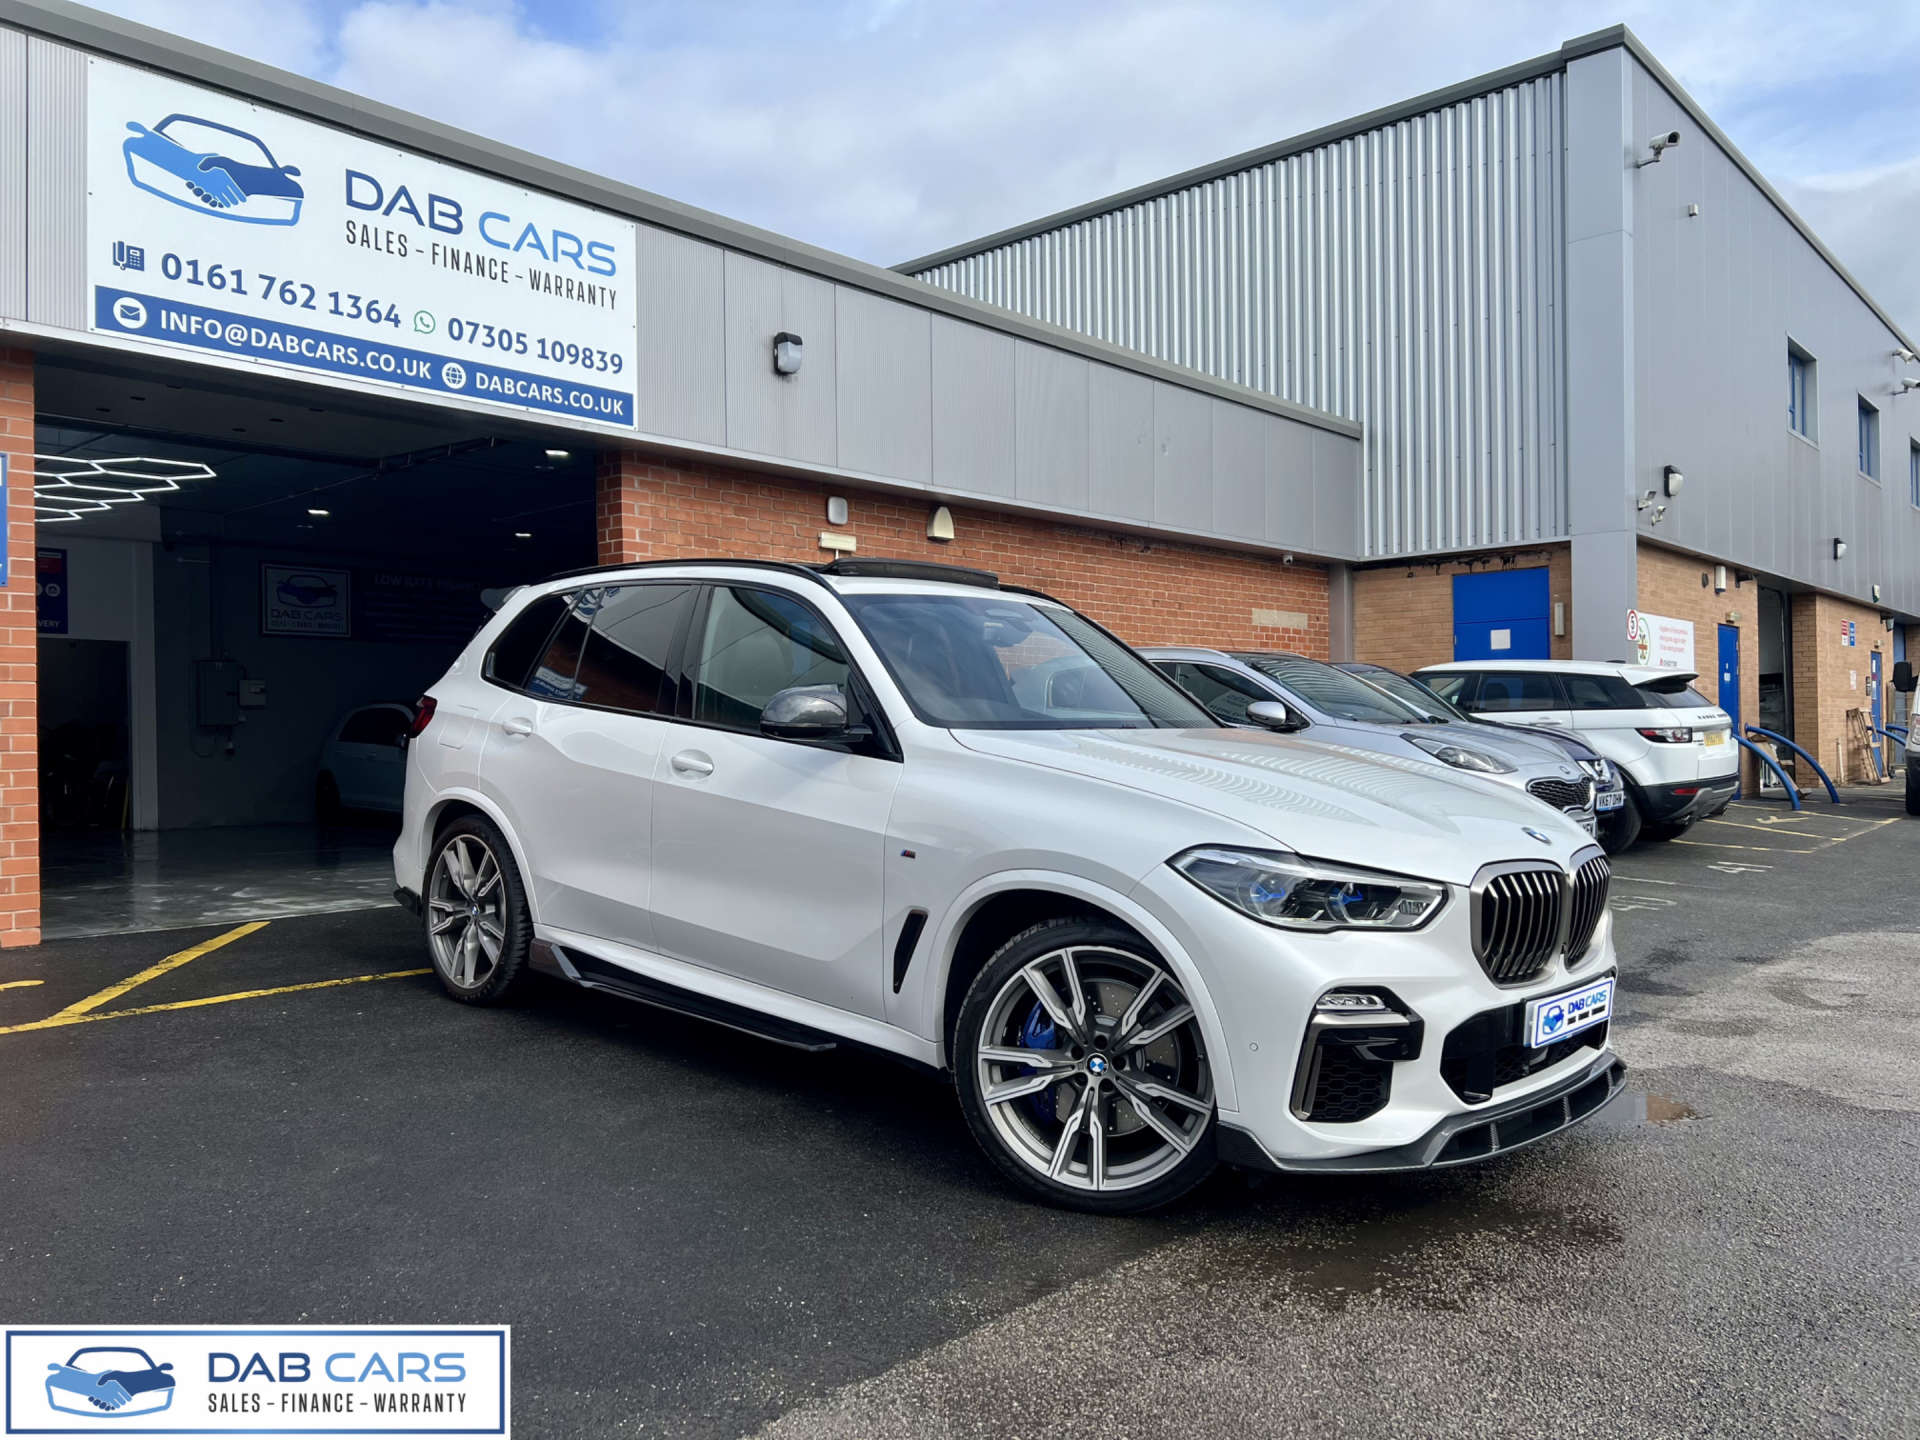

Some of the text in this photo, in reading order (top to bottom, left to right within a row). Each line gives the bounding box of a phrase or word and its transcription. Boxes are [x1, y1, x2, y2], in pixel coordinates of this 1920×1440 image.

[346, 168, 617, 277] DAB CARS
[161, 252, 401, 328] 0161 762 1364
[346, 220, 408, 257] SALES
[432, 243, 509, 284] FINANCE
[529, 268, 617, 310] WARRANTY
[160, 309, 431, 379] INFO@DABCARS.CO.UK
[448, 317, 623, 374] 07305 109839
[475, 372, 624, 416] DABCARS.CO.UK
[1567, 990, 1607, 1014] DAB CARS
